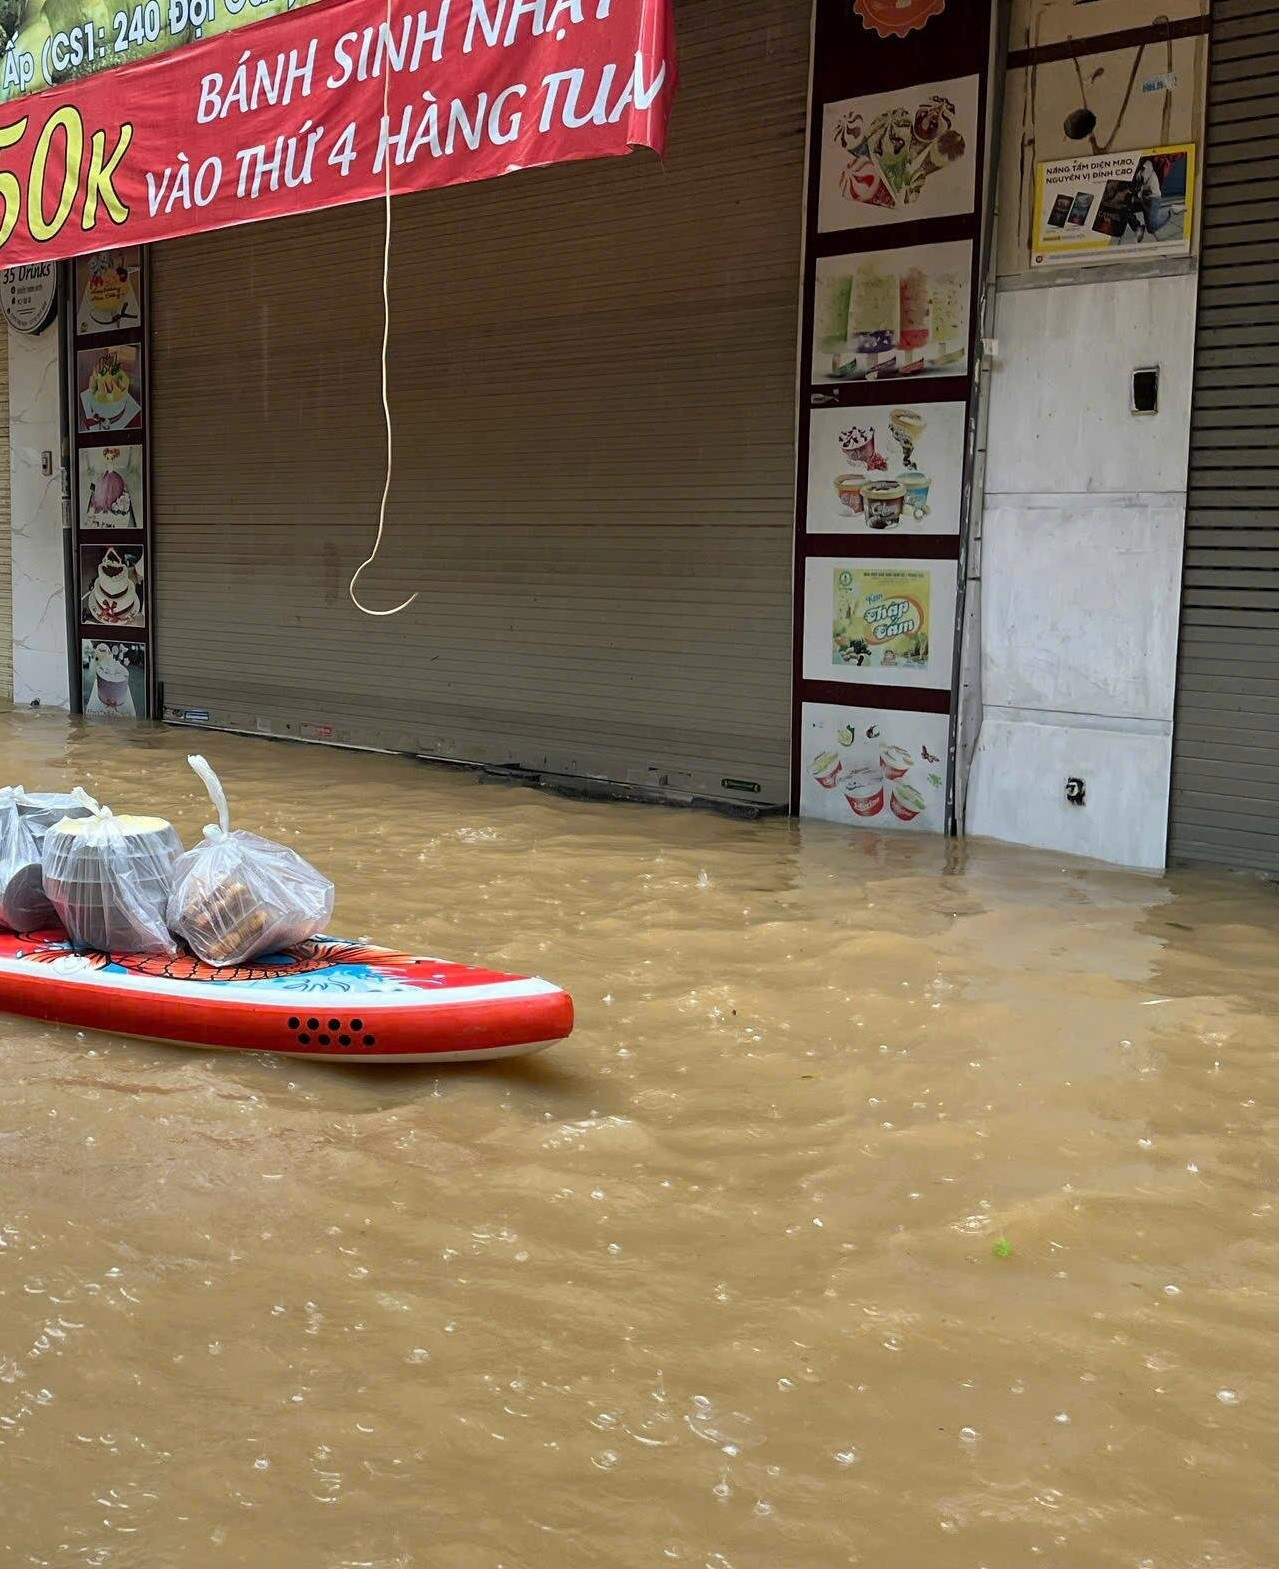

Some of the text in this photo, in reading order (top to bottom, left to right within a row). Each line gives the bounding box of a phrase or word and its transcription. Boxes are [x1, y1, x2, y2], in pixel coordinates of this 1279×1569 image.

[3, 31, 35, 92] Ấp
[41, 19, 106, 84] (CS1:
[113, 0, 161, 52] 240
[196, 38, 317, 125] BÁNH
[326, 0, 450, 88] SINH
[145, 152, 222, 218] VÀO
[236, 118, 326, 199] THỨ
[328, 132, 357, 177] 4
[373, 84, 528, 174] HÀNG
[3, 262, 51, 284] 35 Drinks
